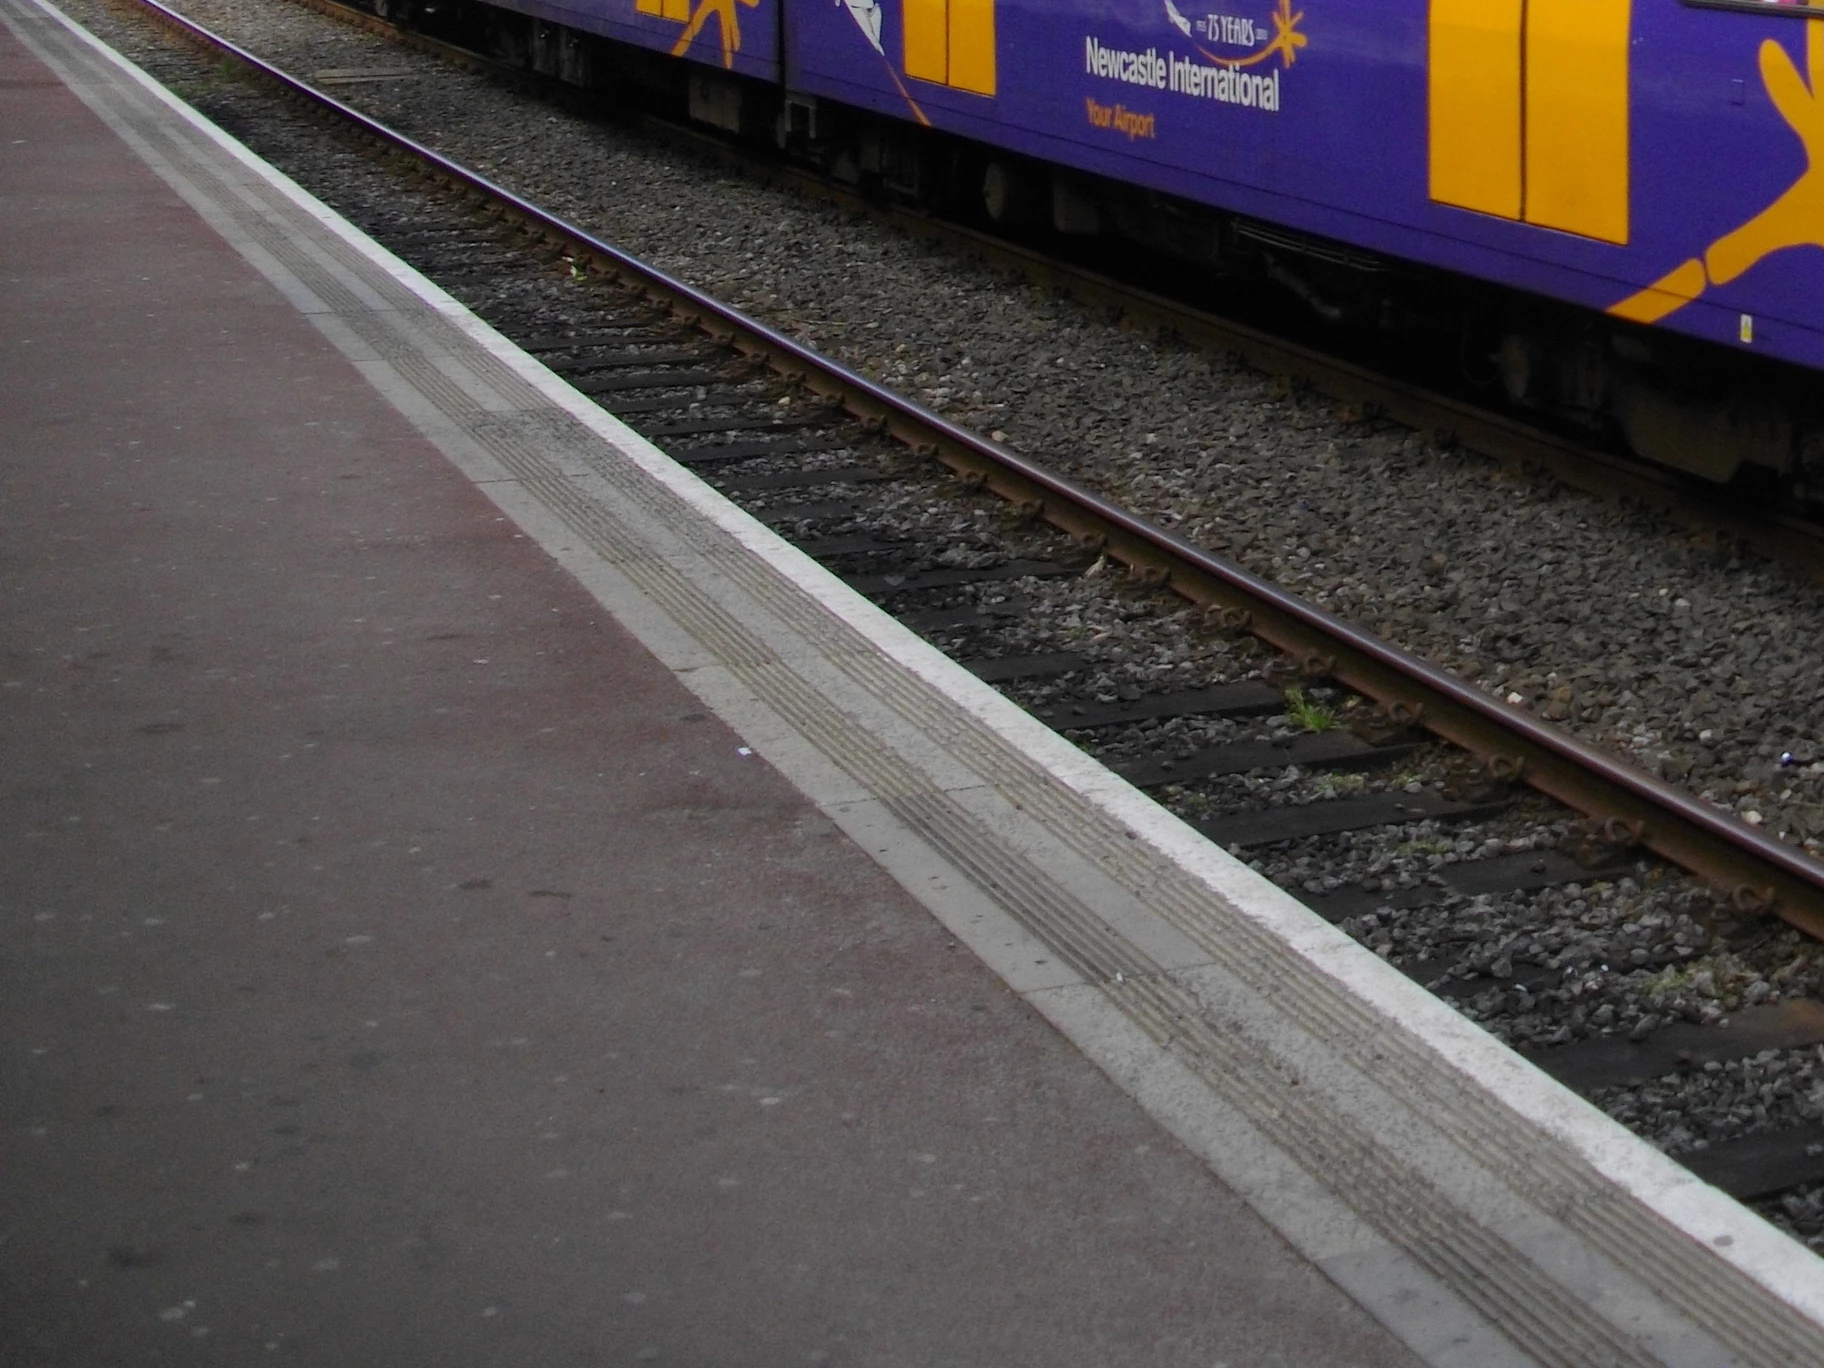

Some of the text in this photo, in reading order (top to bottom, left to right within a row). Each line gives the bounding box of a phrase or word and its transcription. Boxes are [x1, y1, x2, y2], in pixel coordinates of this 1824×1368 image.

[1207, 14, 1219, 42] 75
[1220, 15, 1255, 47] YEARS
[1086, 35, 1280, 112] Newcastle International
[1085, 96, 1155, 142] Your Airport
